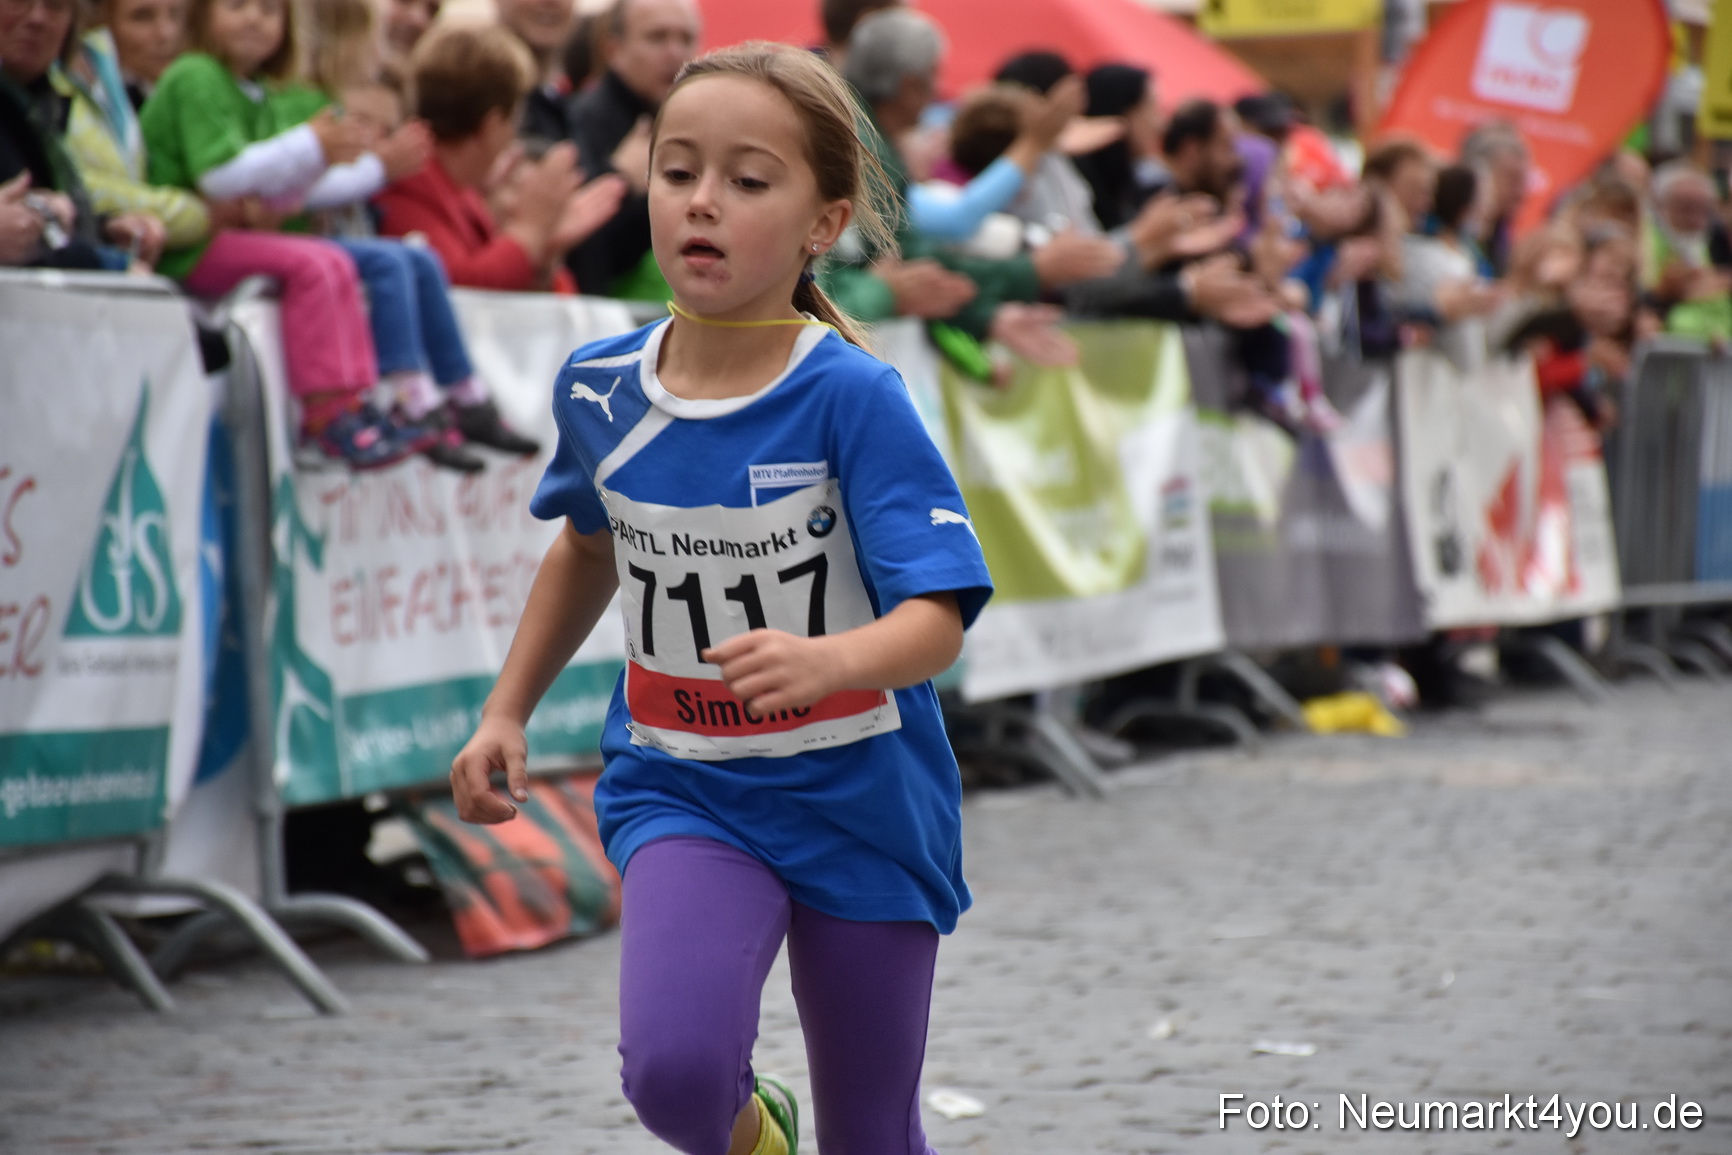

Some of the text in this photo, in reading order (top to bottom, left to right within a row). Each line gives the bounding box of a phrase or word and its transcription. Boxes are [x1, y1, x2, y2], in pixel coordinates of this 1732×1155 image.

[752, 469, 772, 480] MTV
[671, 527, 799, 559] Neumarkt
[628, 552, 829, 664] 7117
